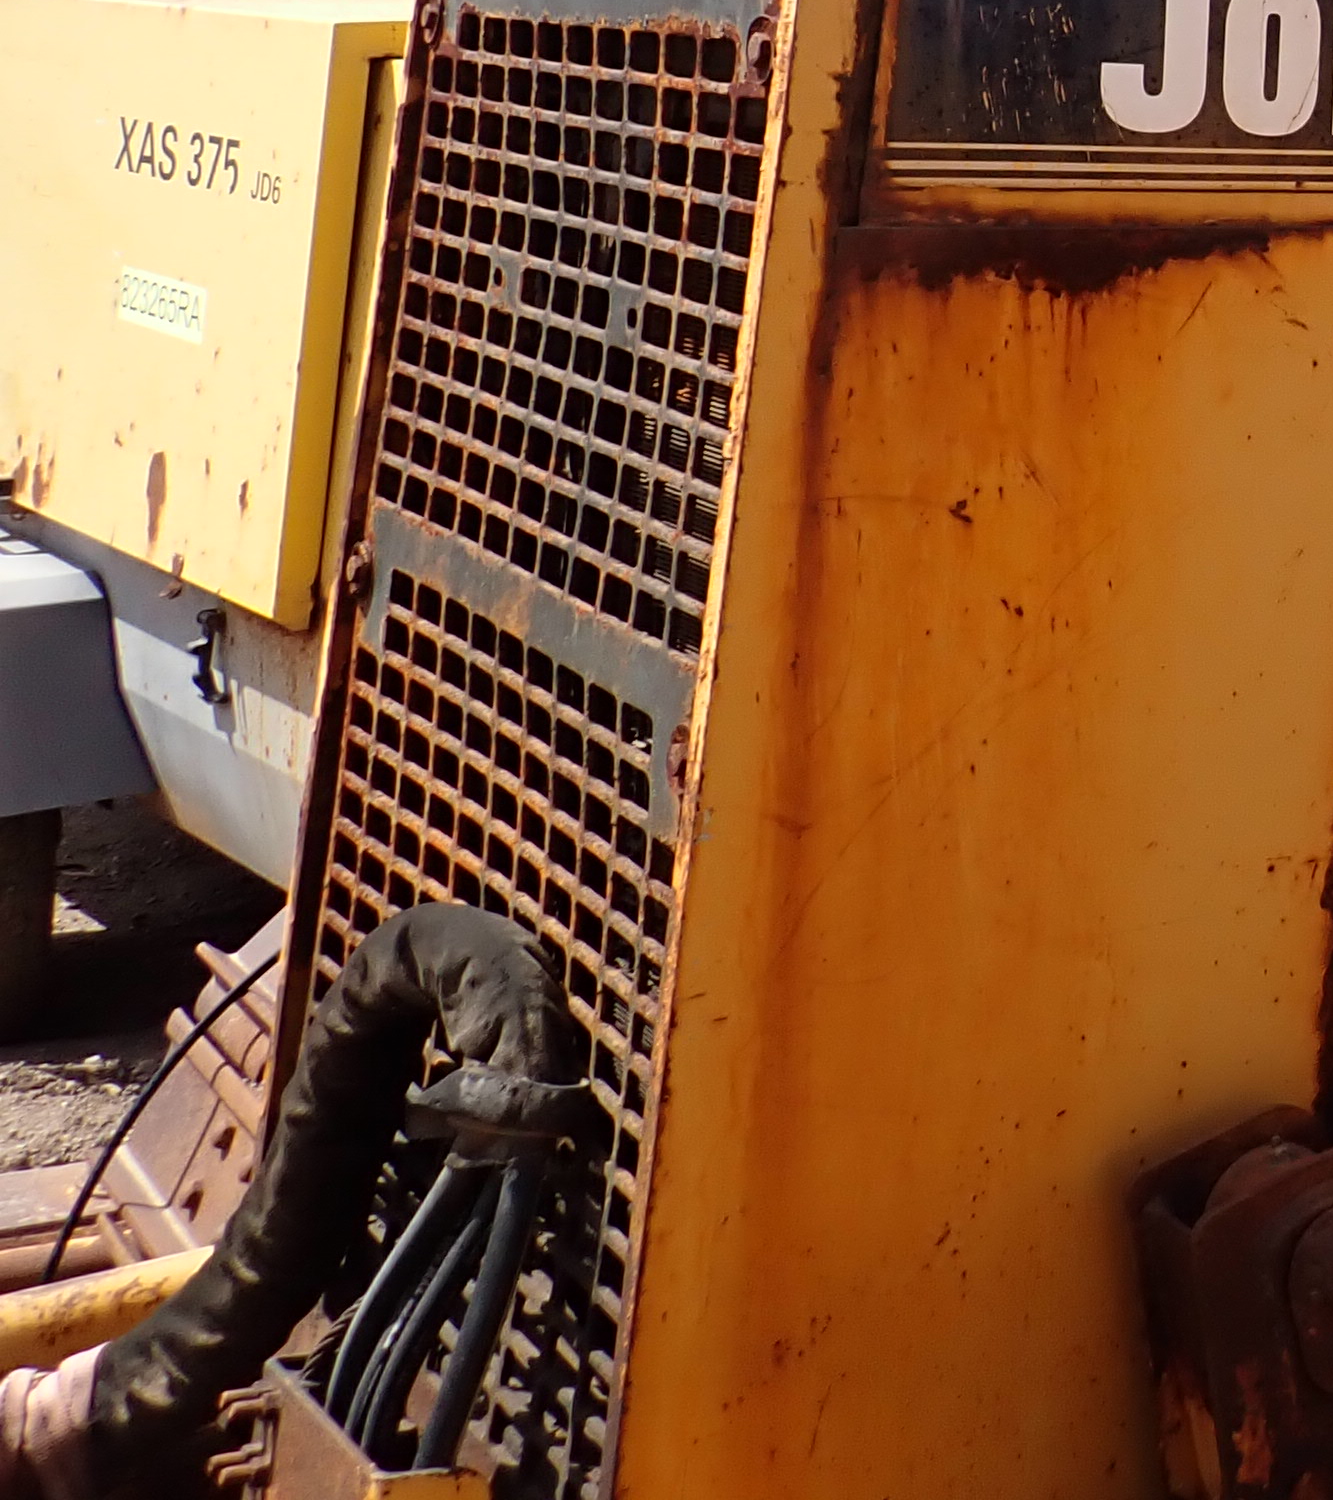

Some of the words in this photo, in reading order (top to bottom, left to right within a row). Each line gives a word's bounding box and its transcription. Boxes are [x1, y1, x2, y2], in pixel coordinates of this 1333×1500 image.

[114, 115, 179, 182] XAS
[186, 131, 241, 196] 375
[249, 170, 282, 205] JD6
